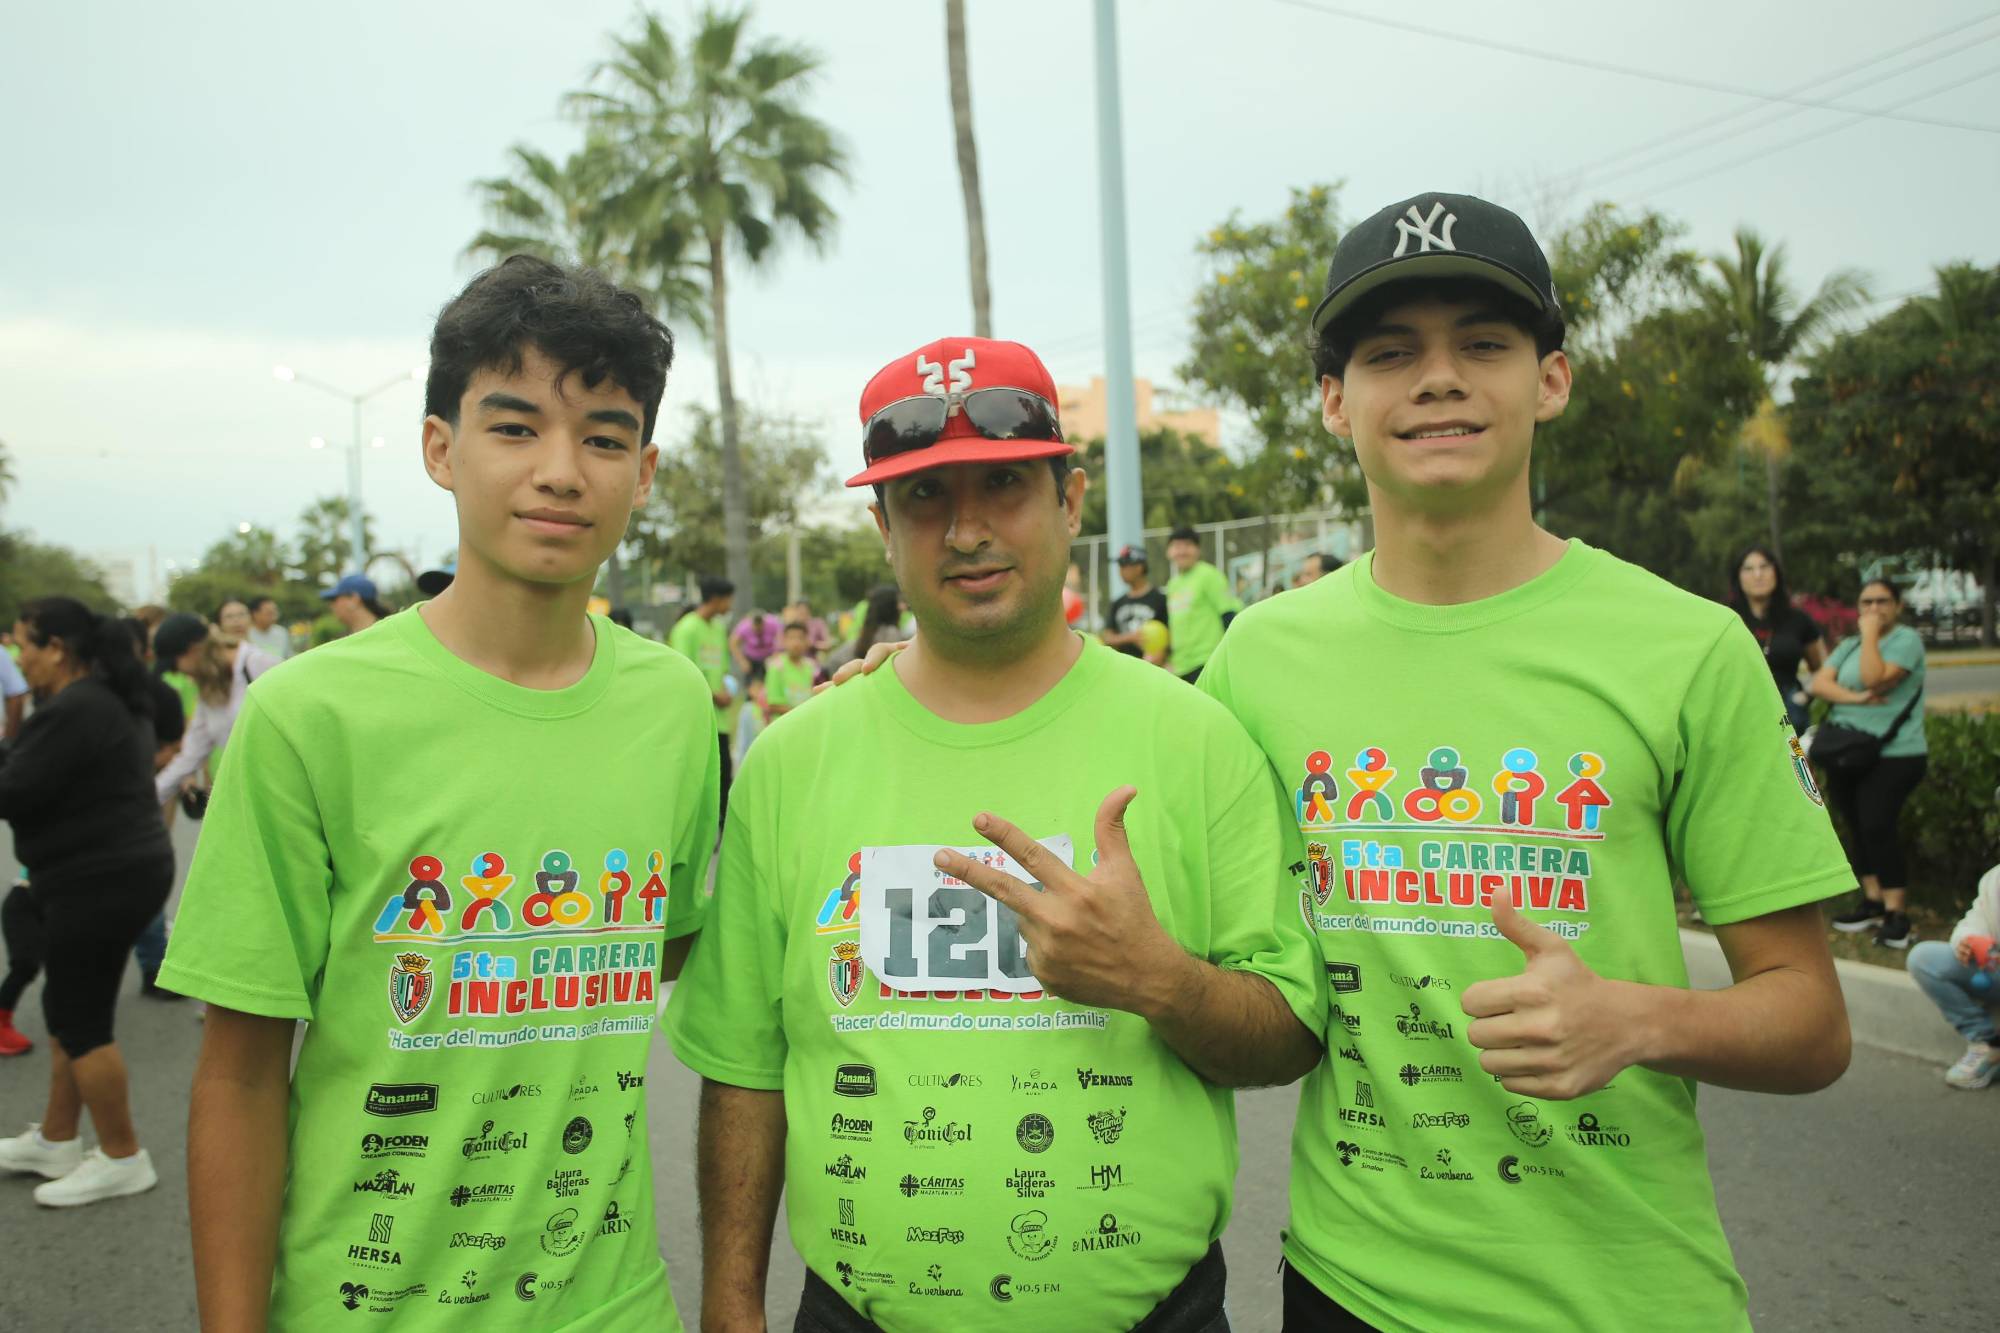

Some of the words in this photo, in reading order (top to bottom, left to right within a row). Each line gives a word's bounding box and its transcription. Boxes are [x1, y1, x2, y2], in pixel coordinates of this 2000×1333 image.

[1343, 841, 1402, 868] 5ta
[1421, 842, 1590, 876] CARRERA
[1344, 869, 1586, 910] INCLUSIVA
[1354, 915, 1370, 930] del
[1373, 918, 1437, 933] mundo
[1441, 922, 1475, 936] una
[1481, 924, 1504, 937] so
[452, 951, 516, 979] 5ta
[532, 942, 656, 974] CARRERA
[449, 971, 653, 1015] INCLUSIVA
[880, 1013, 904, 1027] del
[910, 1014, 973, 1029] mundo
[978, 1017, 1012, 1028] una
[1016, 1014, 1051, 1028] sola
[446, 1027, 473, 1046] del
[478, 1026, 537, 1046] mundo
[542, 1026, 577, 1039] una
[1421, 1064, 1462, 1075] CÁRITAS
[838, 1071, 871, 1084] Panamá
[1077, 1067, 1133, 1090] VENADOS
[368, 1089, 429, 1104] Panamá
[843, 1118, 873, 1132] FODEN
[1339, 1108, 1386, 1128] HERSA
[1412, 1112, 1470, 1128] MazFest
[384, 1135, 429, 1148] FODEN
[555, 1169, 582, 1179] Laura
[1014, 1168, 1046, 1179] Laura
[1523, 1164, 1546, 1175] 90.5
[547, 1176, 590, 1190] Balderas
[920, 1176, 964, 1187] CÁRITAS
[1006, 1177, 1056, 1188] Balderas
[472, 1184, 515, 1195] CÁRITAS
[555, 1186, 579, 1198] Silva
[1016, 1187, 1045, 1198] Silva
[450, 1233, 506, 1250] MazFest
[830, 1227, 867, 1247] HERSA
[906, 1227, 965, 1244] MazFest
[1081, 1231, 1141, 1252] MARINO
[348, 1244, 401, 1265] HERSA
[540, 1280, 563, 1291] 90.5
[925, 1284, 963, 1296] verbena
[1016, 1283, 1040, 1294] 90.5
[1044, 1283, 1060, 1293] FM
